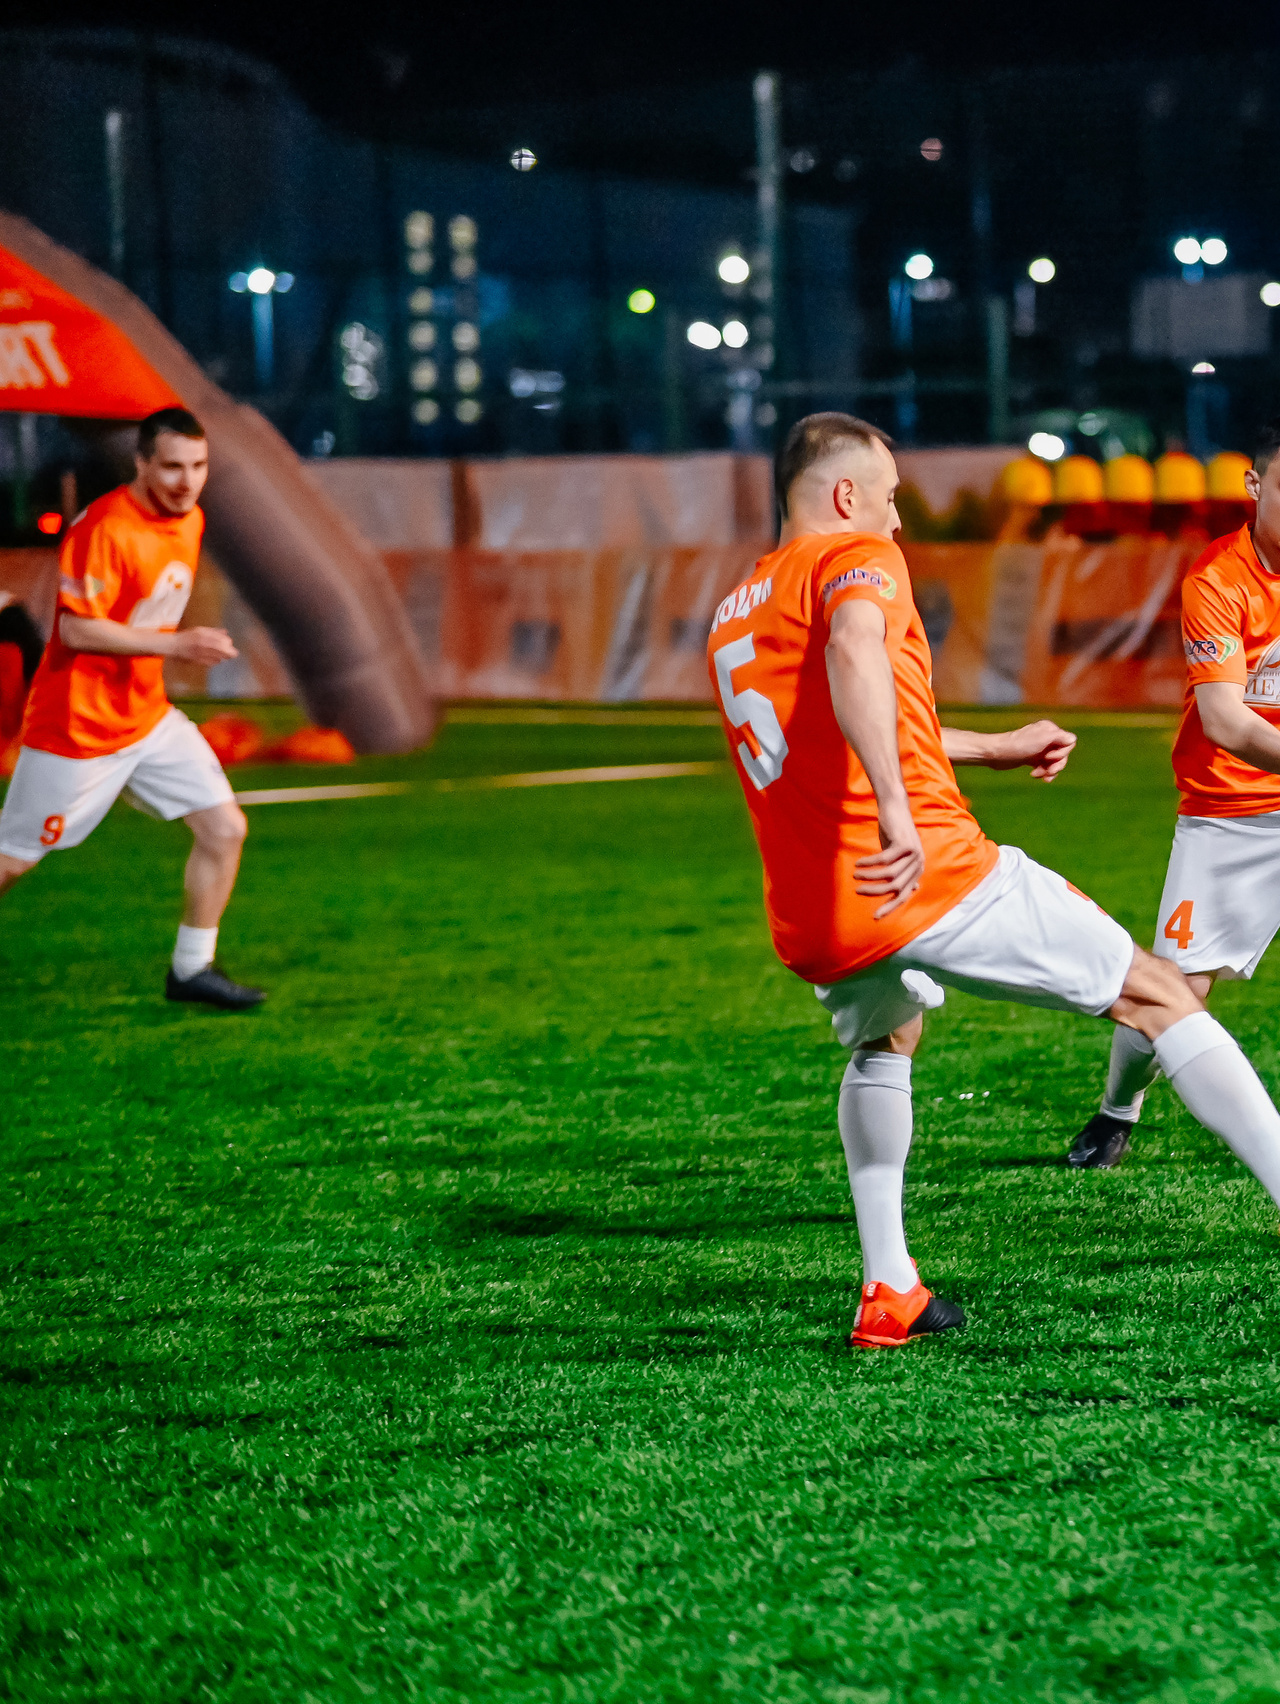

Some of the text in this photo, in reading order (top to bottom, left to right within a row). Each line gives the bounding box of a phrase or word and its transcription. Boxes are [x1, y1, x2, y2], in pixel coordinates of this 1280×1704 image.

[0, 320, 69, 388] RT
[713, 631, 790, 791] 5
[39, 813, 65, 846] 9
[1164, 899, 1194, 950] 4
